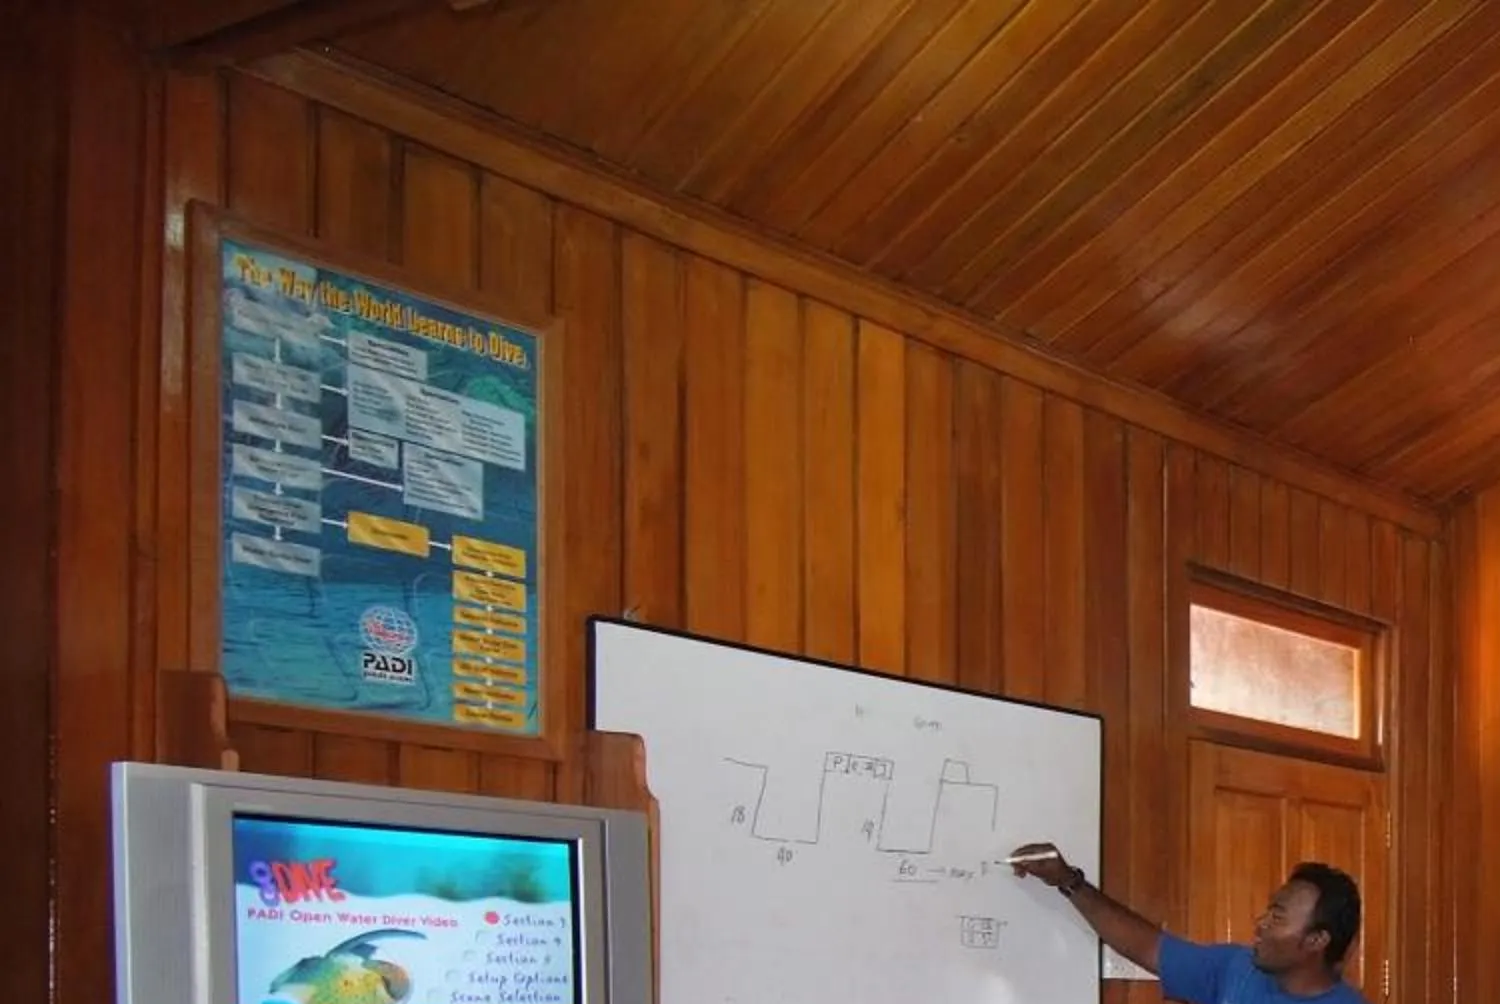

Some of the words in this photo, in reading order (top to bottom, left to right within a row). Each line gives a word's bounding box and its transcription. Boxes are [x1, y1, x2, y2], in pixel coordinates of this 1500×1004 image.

[353, 289, 404, 330] World
[408, 306, 466, 349] Learns
[468, 326, 484, 356] to
[363, 653, 412, 675] PADI
[247, 908, 284, 921] PADI
[290, 910, 331, 923] Open
[337, 912, 377, 925] Water
[383, 914, 416, 926] Diver
[420, 915, 458, 928] Video
[503, 914, 555, 927] Section
[497, 933, 547, 945] Section
